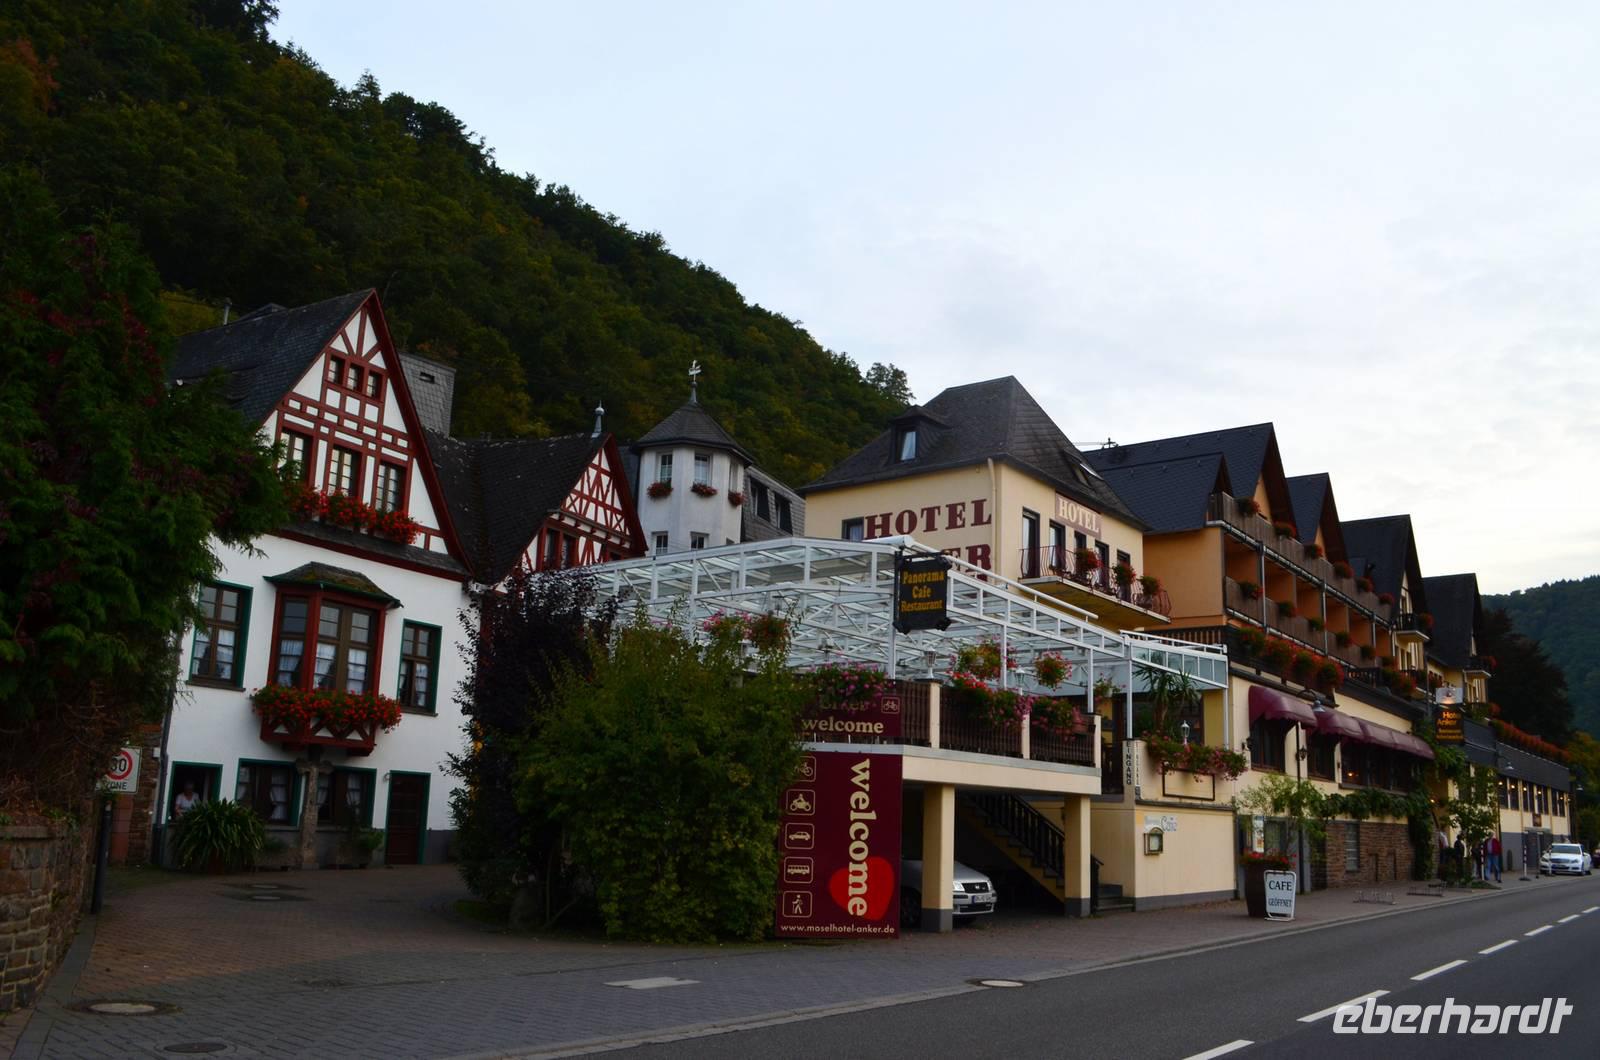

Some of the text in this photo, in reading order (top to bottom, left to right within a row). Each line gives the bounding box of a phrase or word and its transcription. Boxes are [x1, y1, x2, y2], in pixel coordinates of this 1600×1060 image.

[864, 498, 992, 540] HOTEL
[1058, 497, 1100, 533] HOTEL
[902, 570, 945, 584] Panorama
[911, 585, 932, 599] Cafe
[900, 599, 943, 612] Restaurant
[800, 715, 884, 734] welcome
[111, 758, 127, 772] 30
[847, 758, 876, 917] welcome
[1268, 880, 1293, 892] CAFE
[780, 923, 895, 934] www.moselhotel-anker.de
